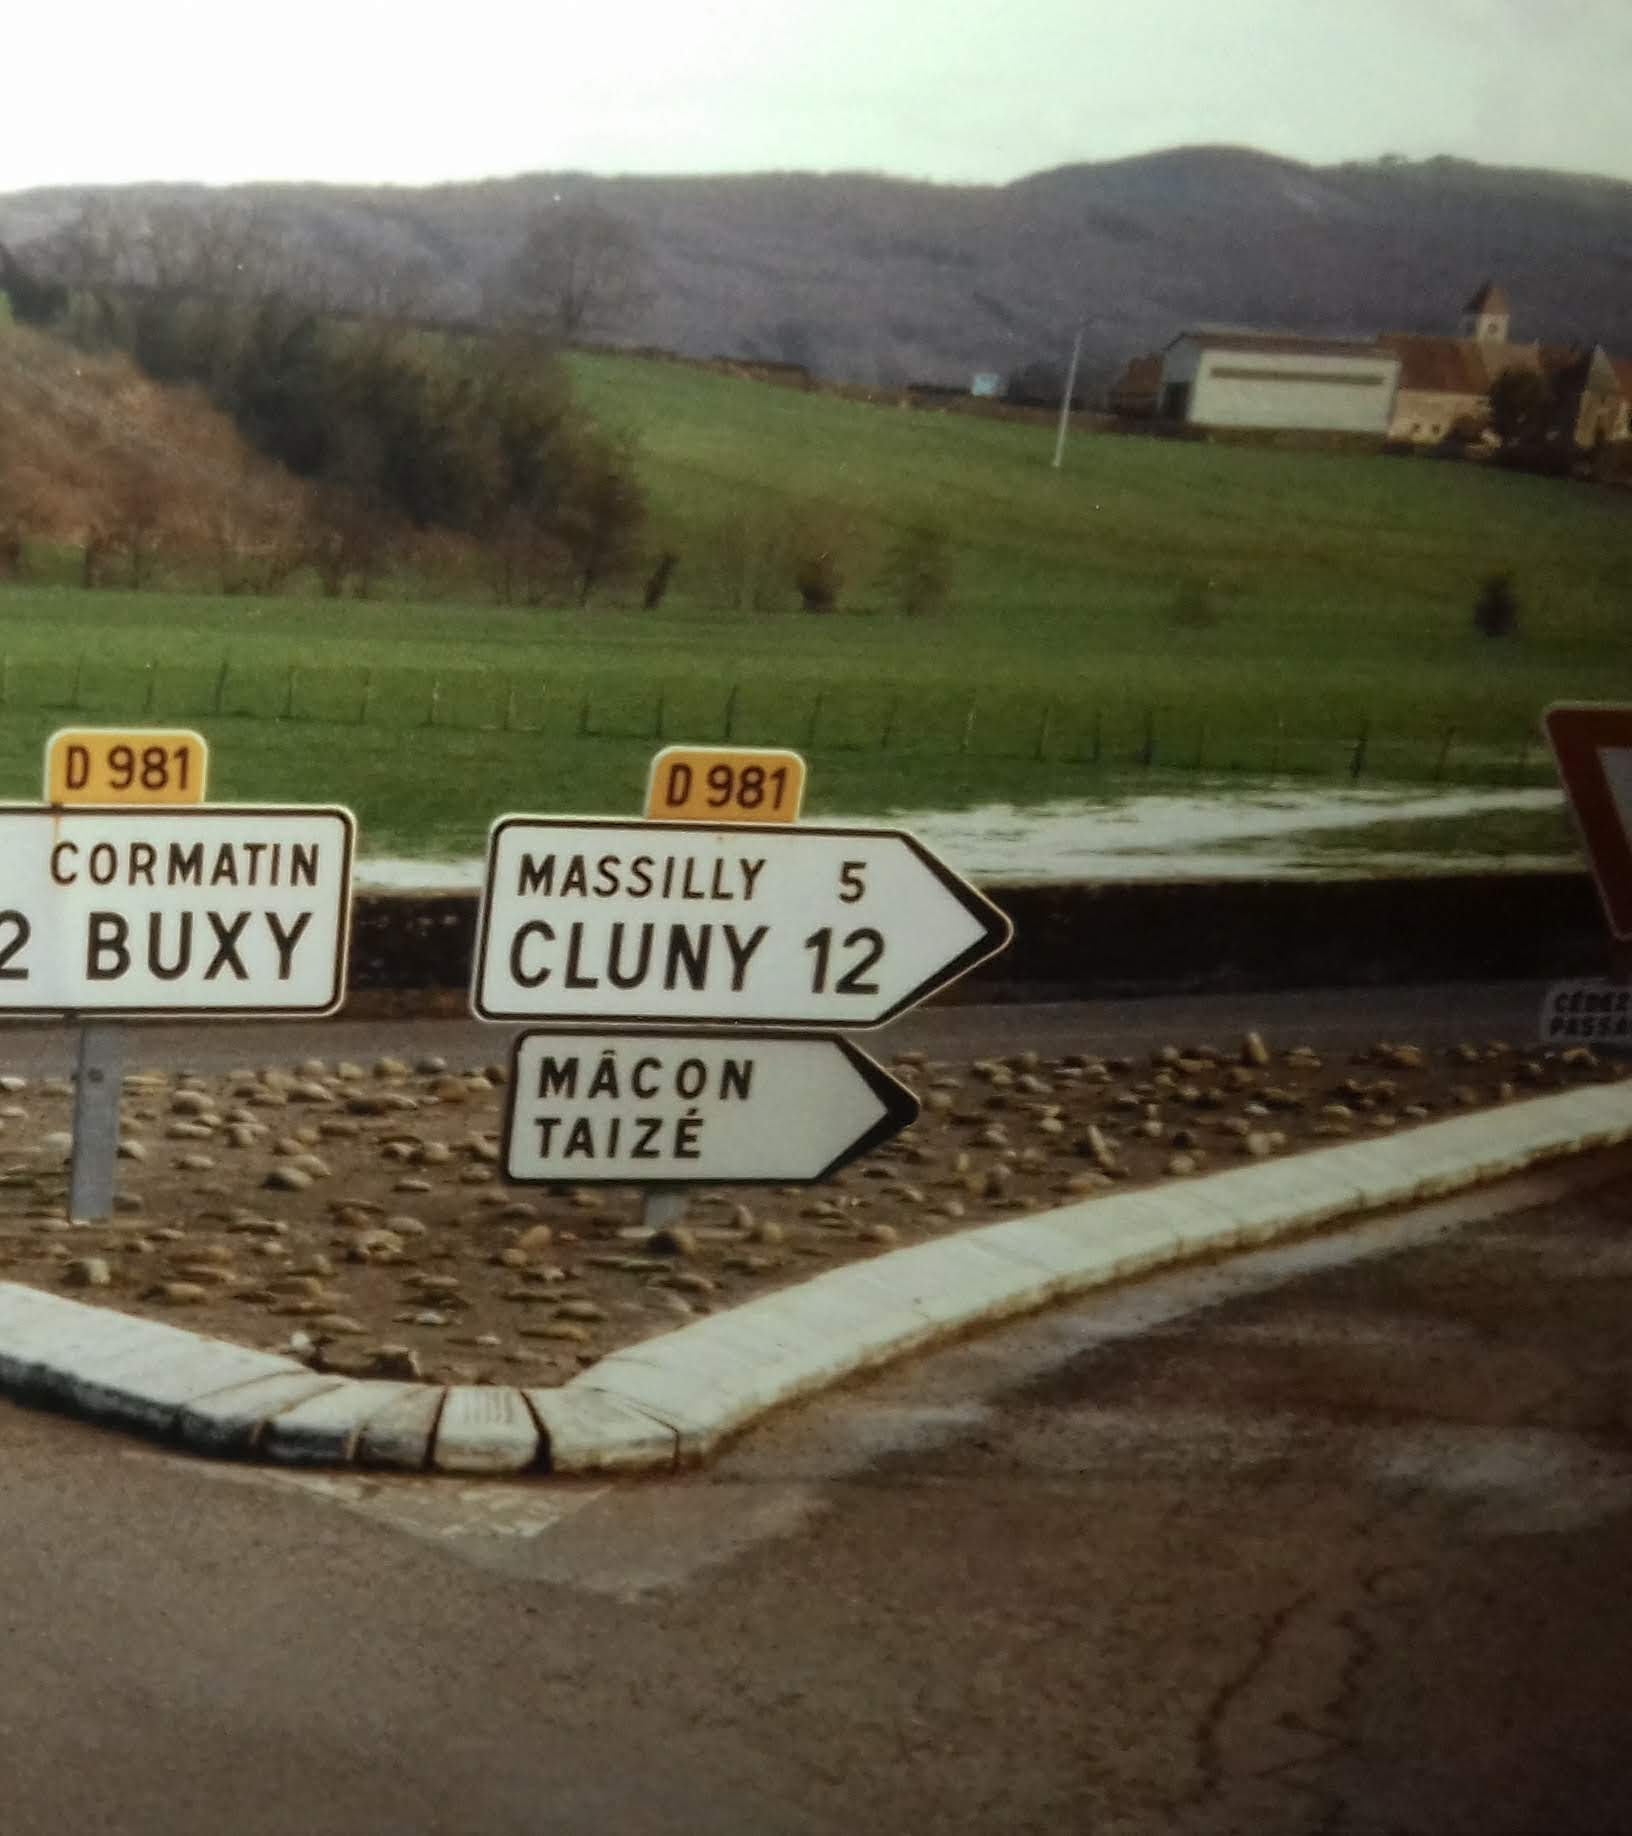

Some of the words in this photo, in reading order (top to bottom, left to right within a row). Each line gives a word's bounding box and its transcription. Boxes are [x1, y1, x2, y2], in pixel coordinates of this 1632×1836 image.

[65, 746, 90, 791] D
[108, 746, 191, 791] 981
[667, 764, 693, 807] D
[706, 766, 788, 810] 981
[50, 842, 319, 886] CORMATIN
[517, 854, 766, 900] MASSILLY
[838, 861, 866, 903] 5
[85, 912, 313, 980] BUXY
[509, 920, 770, 991] CLUNY
[804, 928, 885, 995] 12
[538, 1050, 754, 1100] MÂCON
[534, 1109, 704, 1159] TAIZÉ
